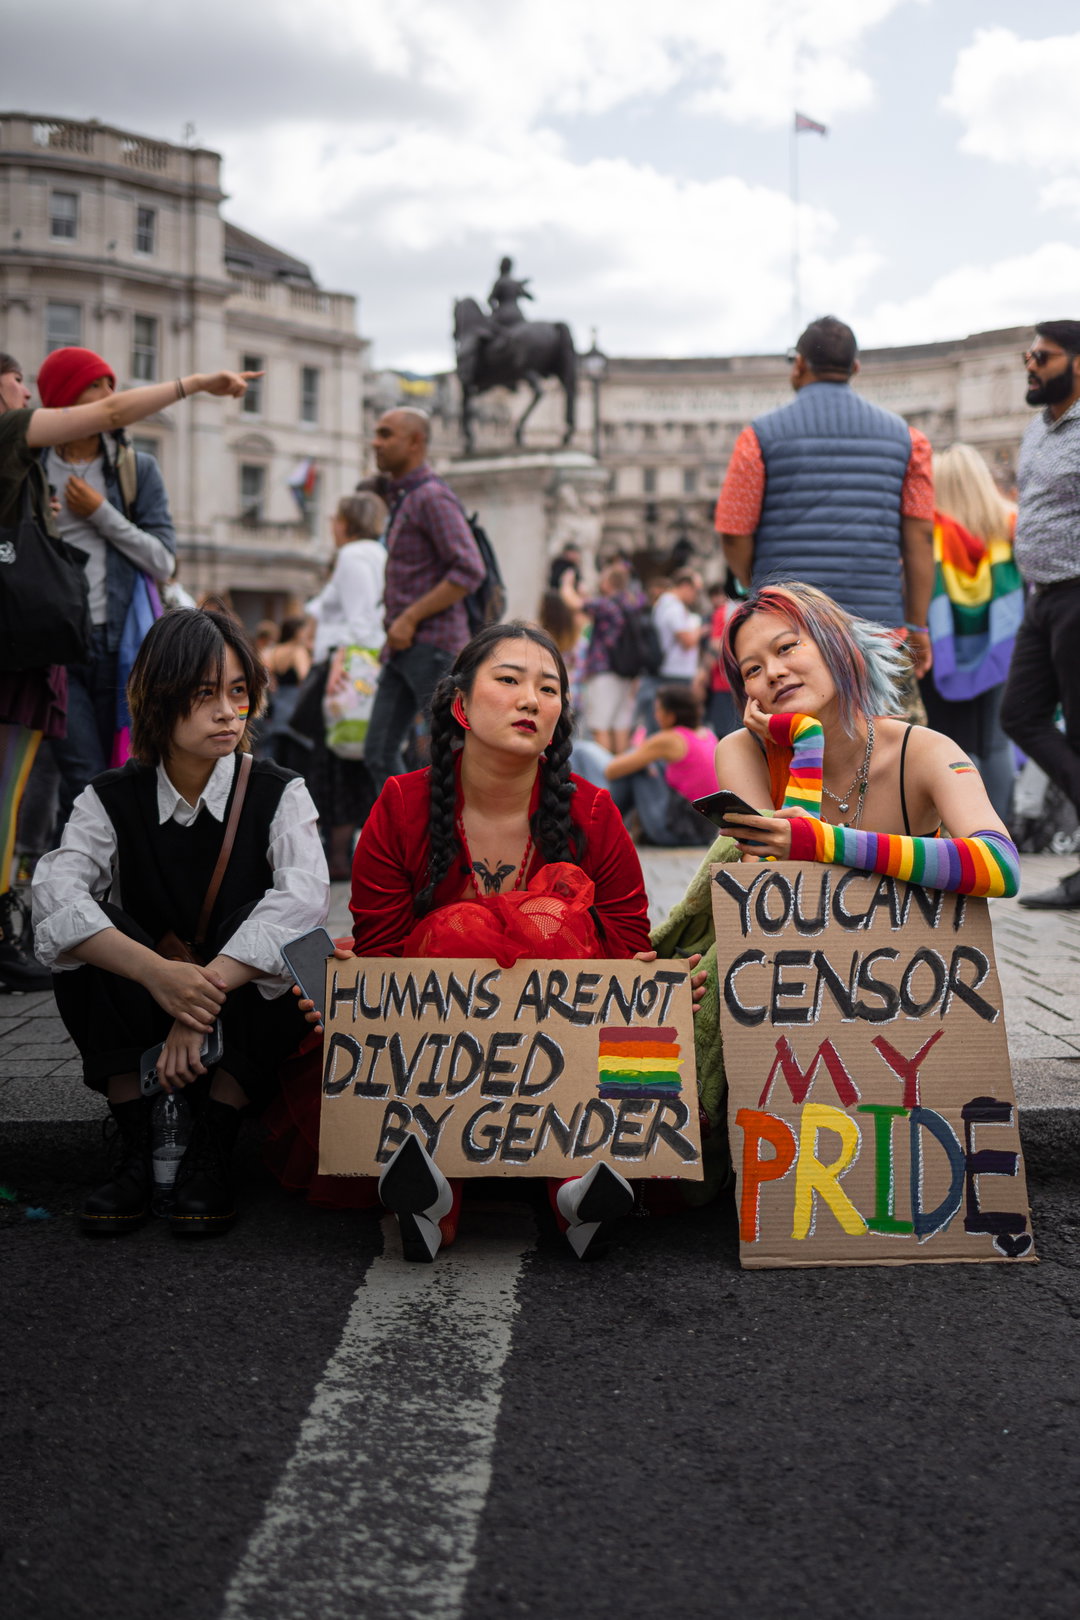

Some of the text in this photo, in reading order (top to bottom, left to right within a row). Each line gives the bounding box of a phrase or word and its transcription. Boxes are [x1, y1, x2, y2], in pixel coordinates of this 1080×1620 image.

[714, 869, 832, 937] YOU
[330, 969, 688, 1026] HUMANS ARE NOT
[724, 945, 1000, 1028] CENSOR
[323, 1031, 566, 1100] DIVIDED
[757, 1028, 945, 1108] MY
[374, 1098, 700, 1166] BY GENDER
[735, 1096, 1027, 1244] PRIDE
